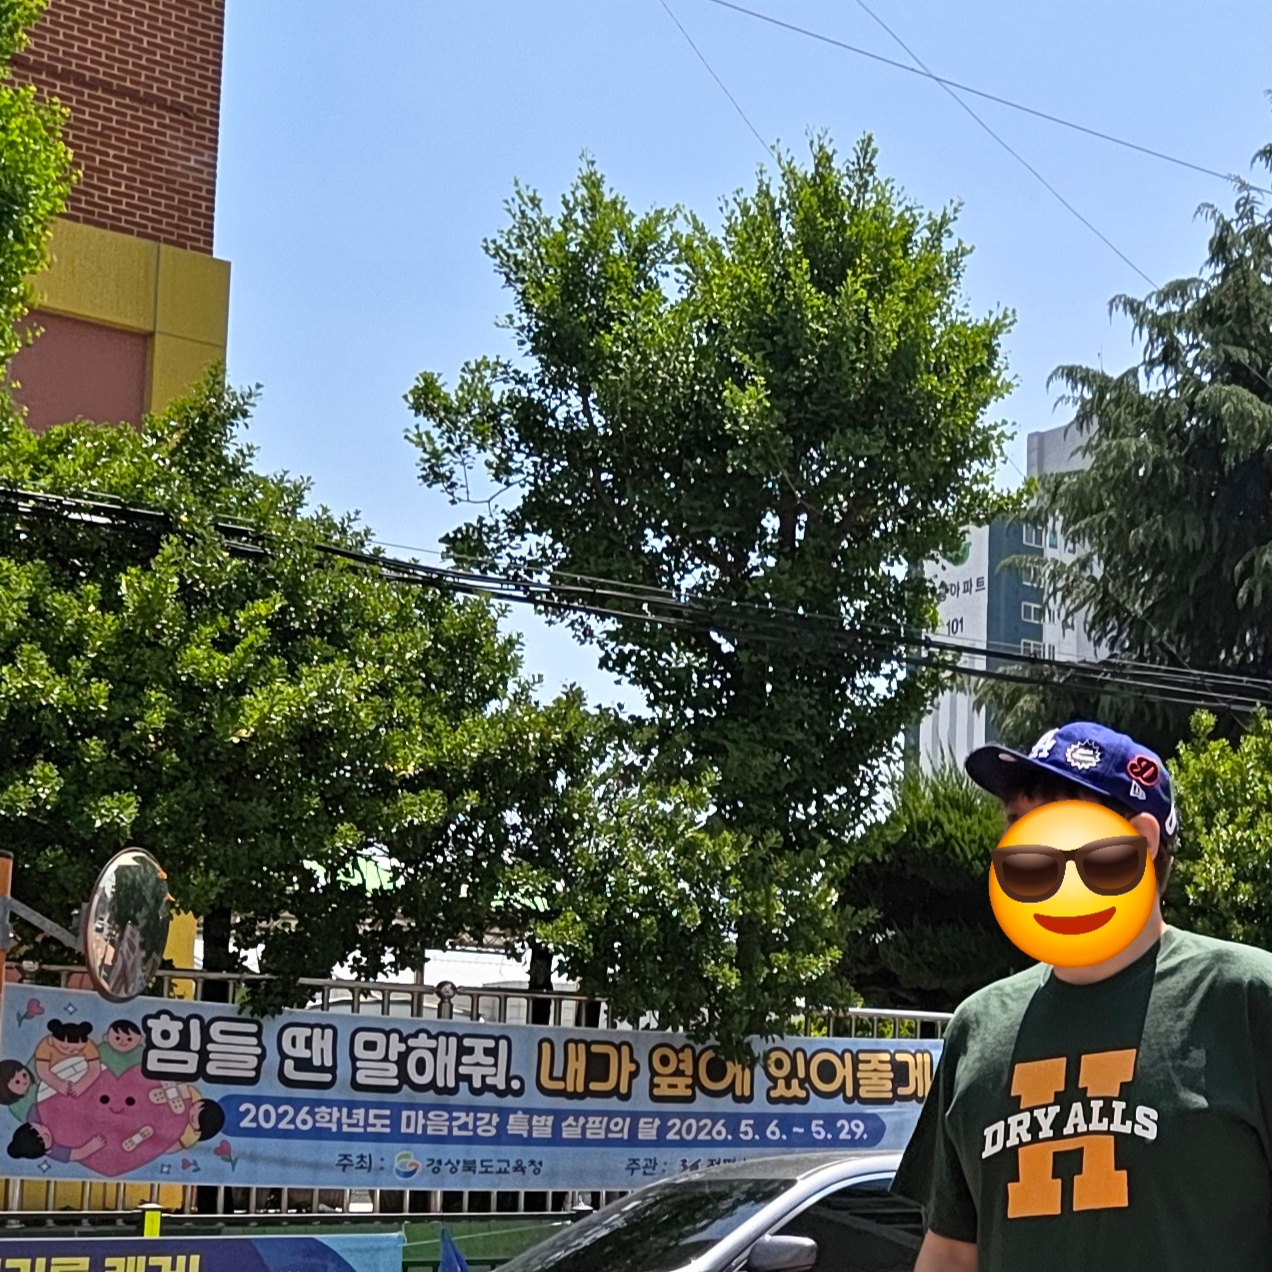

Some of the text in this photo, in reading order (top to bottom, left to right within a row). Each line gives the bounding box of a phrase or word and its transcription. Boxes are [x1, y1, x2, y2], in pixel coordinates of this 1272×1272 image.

[946, 616, 964, 636] 101
[147, 1014, 931, 1098] 힘들 땐 말해줘. 내가 옆에 있어줄게
[239, 1103, 391, 1133] 2026학년도
[400, 1110, 500, 1137] 마음건강
[507, 1110, 554, 1139] 특별
[561, 1115, 631, 1140] 살핌의
[637, 1117, 661, 1141] 달
[666, 1119, 733, 1141] 2026.
[739, 1119, 760, 1141] 5.
[766, 1119, 788, 1141] 6.
[811, 1120, 833, 1141] 5.
[836, 1120, 868, 1141] 29.
[335, 1153, 373, 1173] 주최
[425, 1157, 543, 1176] 경상북도교육청
[625, 1157, 658, 1176] 주관
